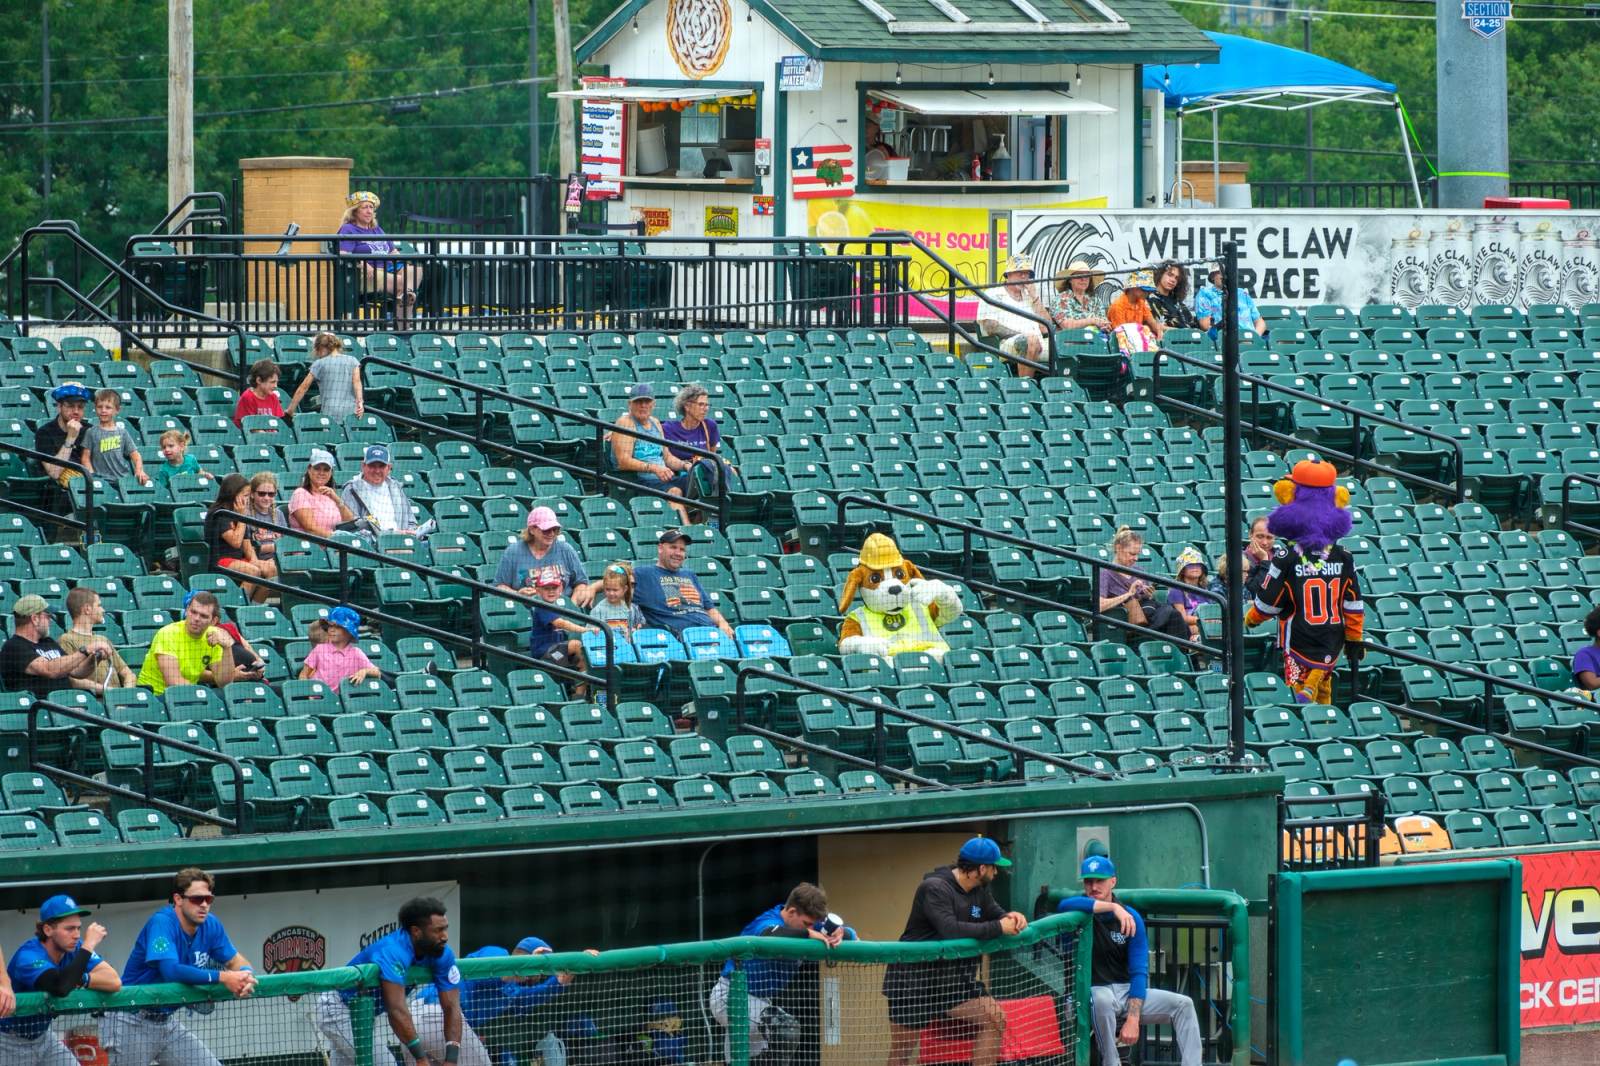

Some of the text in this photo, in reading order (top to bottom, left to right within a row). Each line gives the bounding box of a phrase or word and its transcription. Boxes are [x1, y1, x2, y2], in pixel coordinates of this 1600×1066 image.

[1468, 3, 1506, 16] SECTION
[1474, 18, 1501, 27] 24-25
[783, 75, 804, 86] WATER
[784, 65, 805, 75] BOTTLED
[1139, 227, 1353, 259] WHITE CLAW
[1391, 255, 1429, 297] WHITE CLAW
[1429, 249, 1472, 293] WHITE CLAW
[1473, 242, 1518, 287] WHITE CLAW
[1519, 249, 1560, 292] WHITE CLAW
[1573, 256, 1599, 276] CLAW
[1185, 267, 1321, 299] ERACE
[100, 435, 121, 453] NIKE
[1303, 578, 1341, 625] 01
[272, 928, 316, 942] LANCASTER
[264, 936, 325, 972] STORMERS
